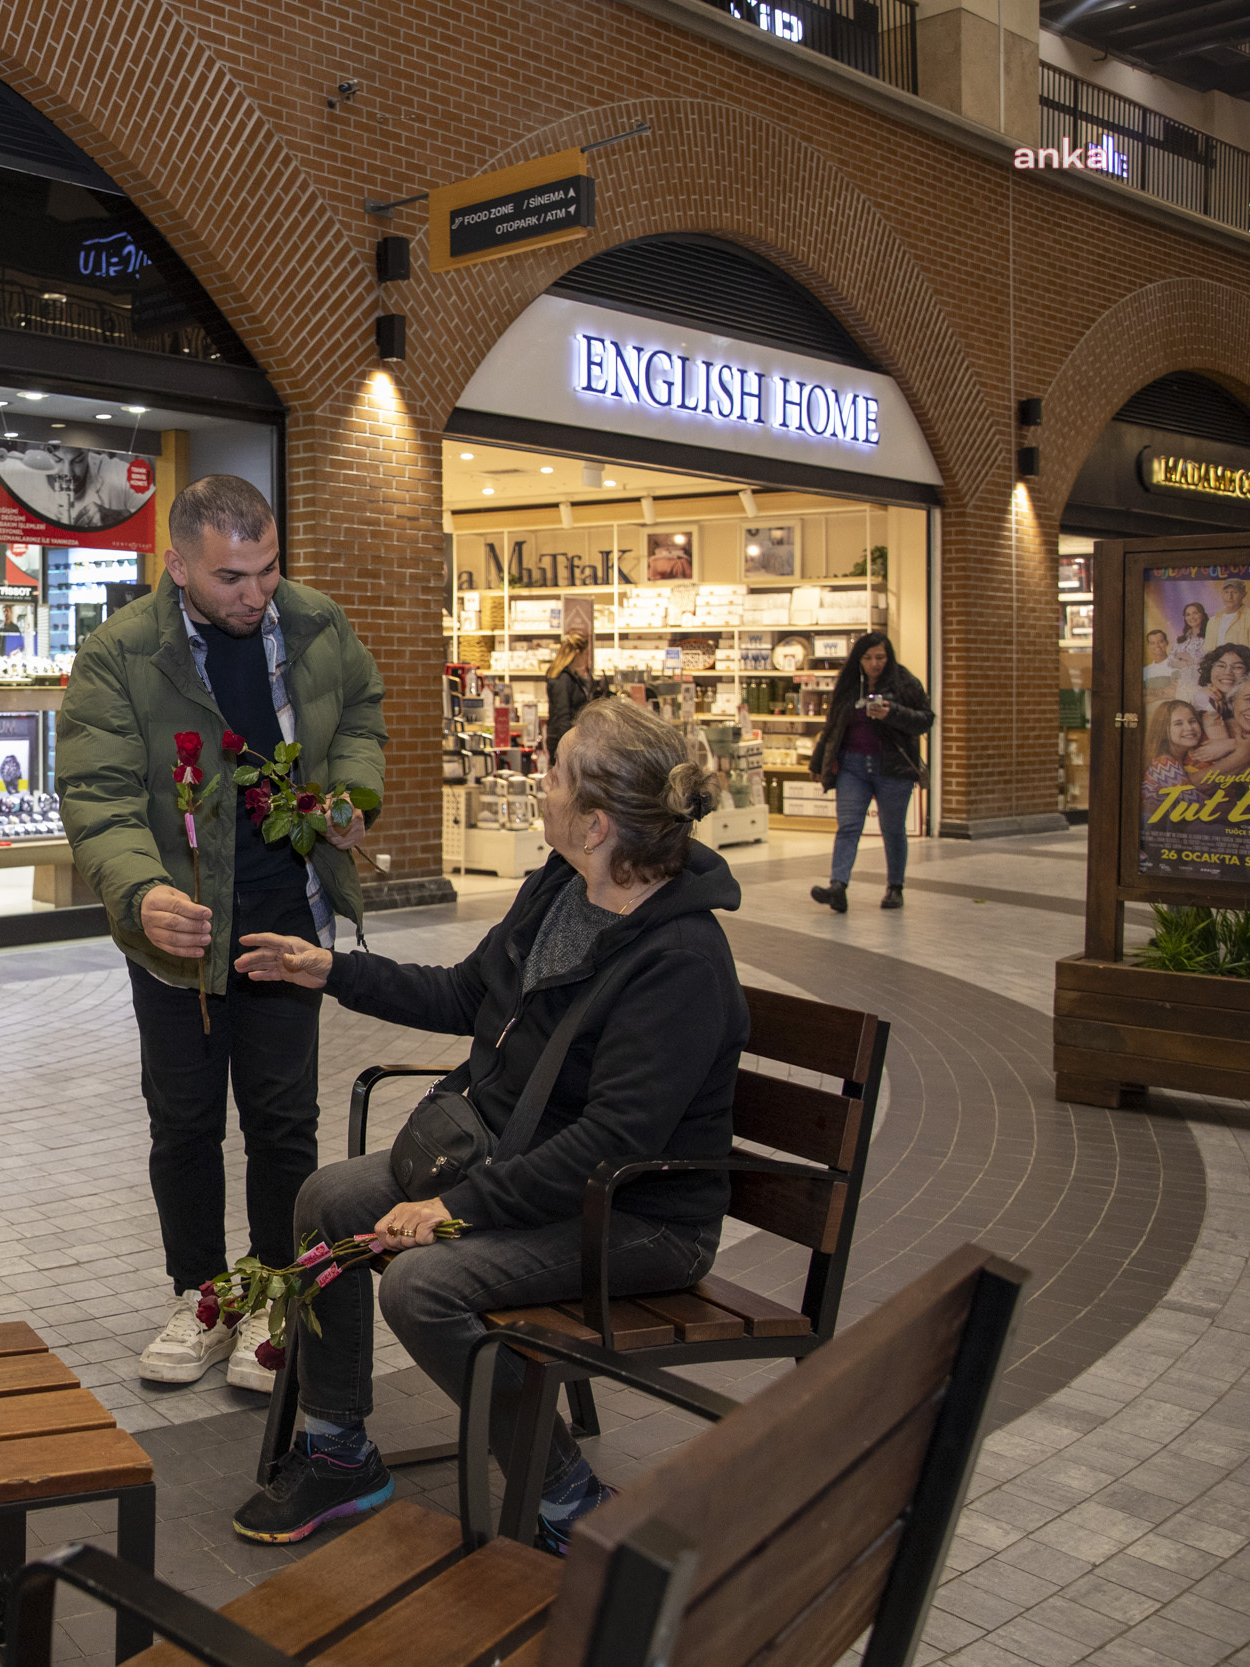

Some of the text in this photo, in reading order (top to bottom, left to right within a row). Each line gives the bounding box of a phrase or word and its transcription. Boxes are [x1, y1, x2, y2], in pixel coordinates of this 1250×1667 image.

[464, 212, 489, 226] FOOD
[490, 203, 514, 218] ZONE
[495, 215, 539, 235] OTOPARK
[546, 208, 566, 222] ATM
[576, 334, 880, 446] ENGLISH HOME
[0, 586, 31, 596] TISSOT
[1147, 784, 1229, 824] Tut
[1161, 849, 1178, 860] 26
[1182, 851, 1241, 866] OCAK'TA
